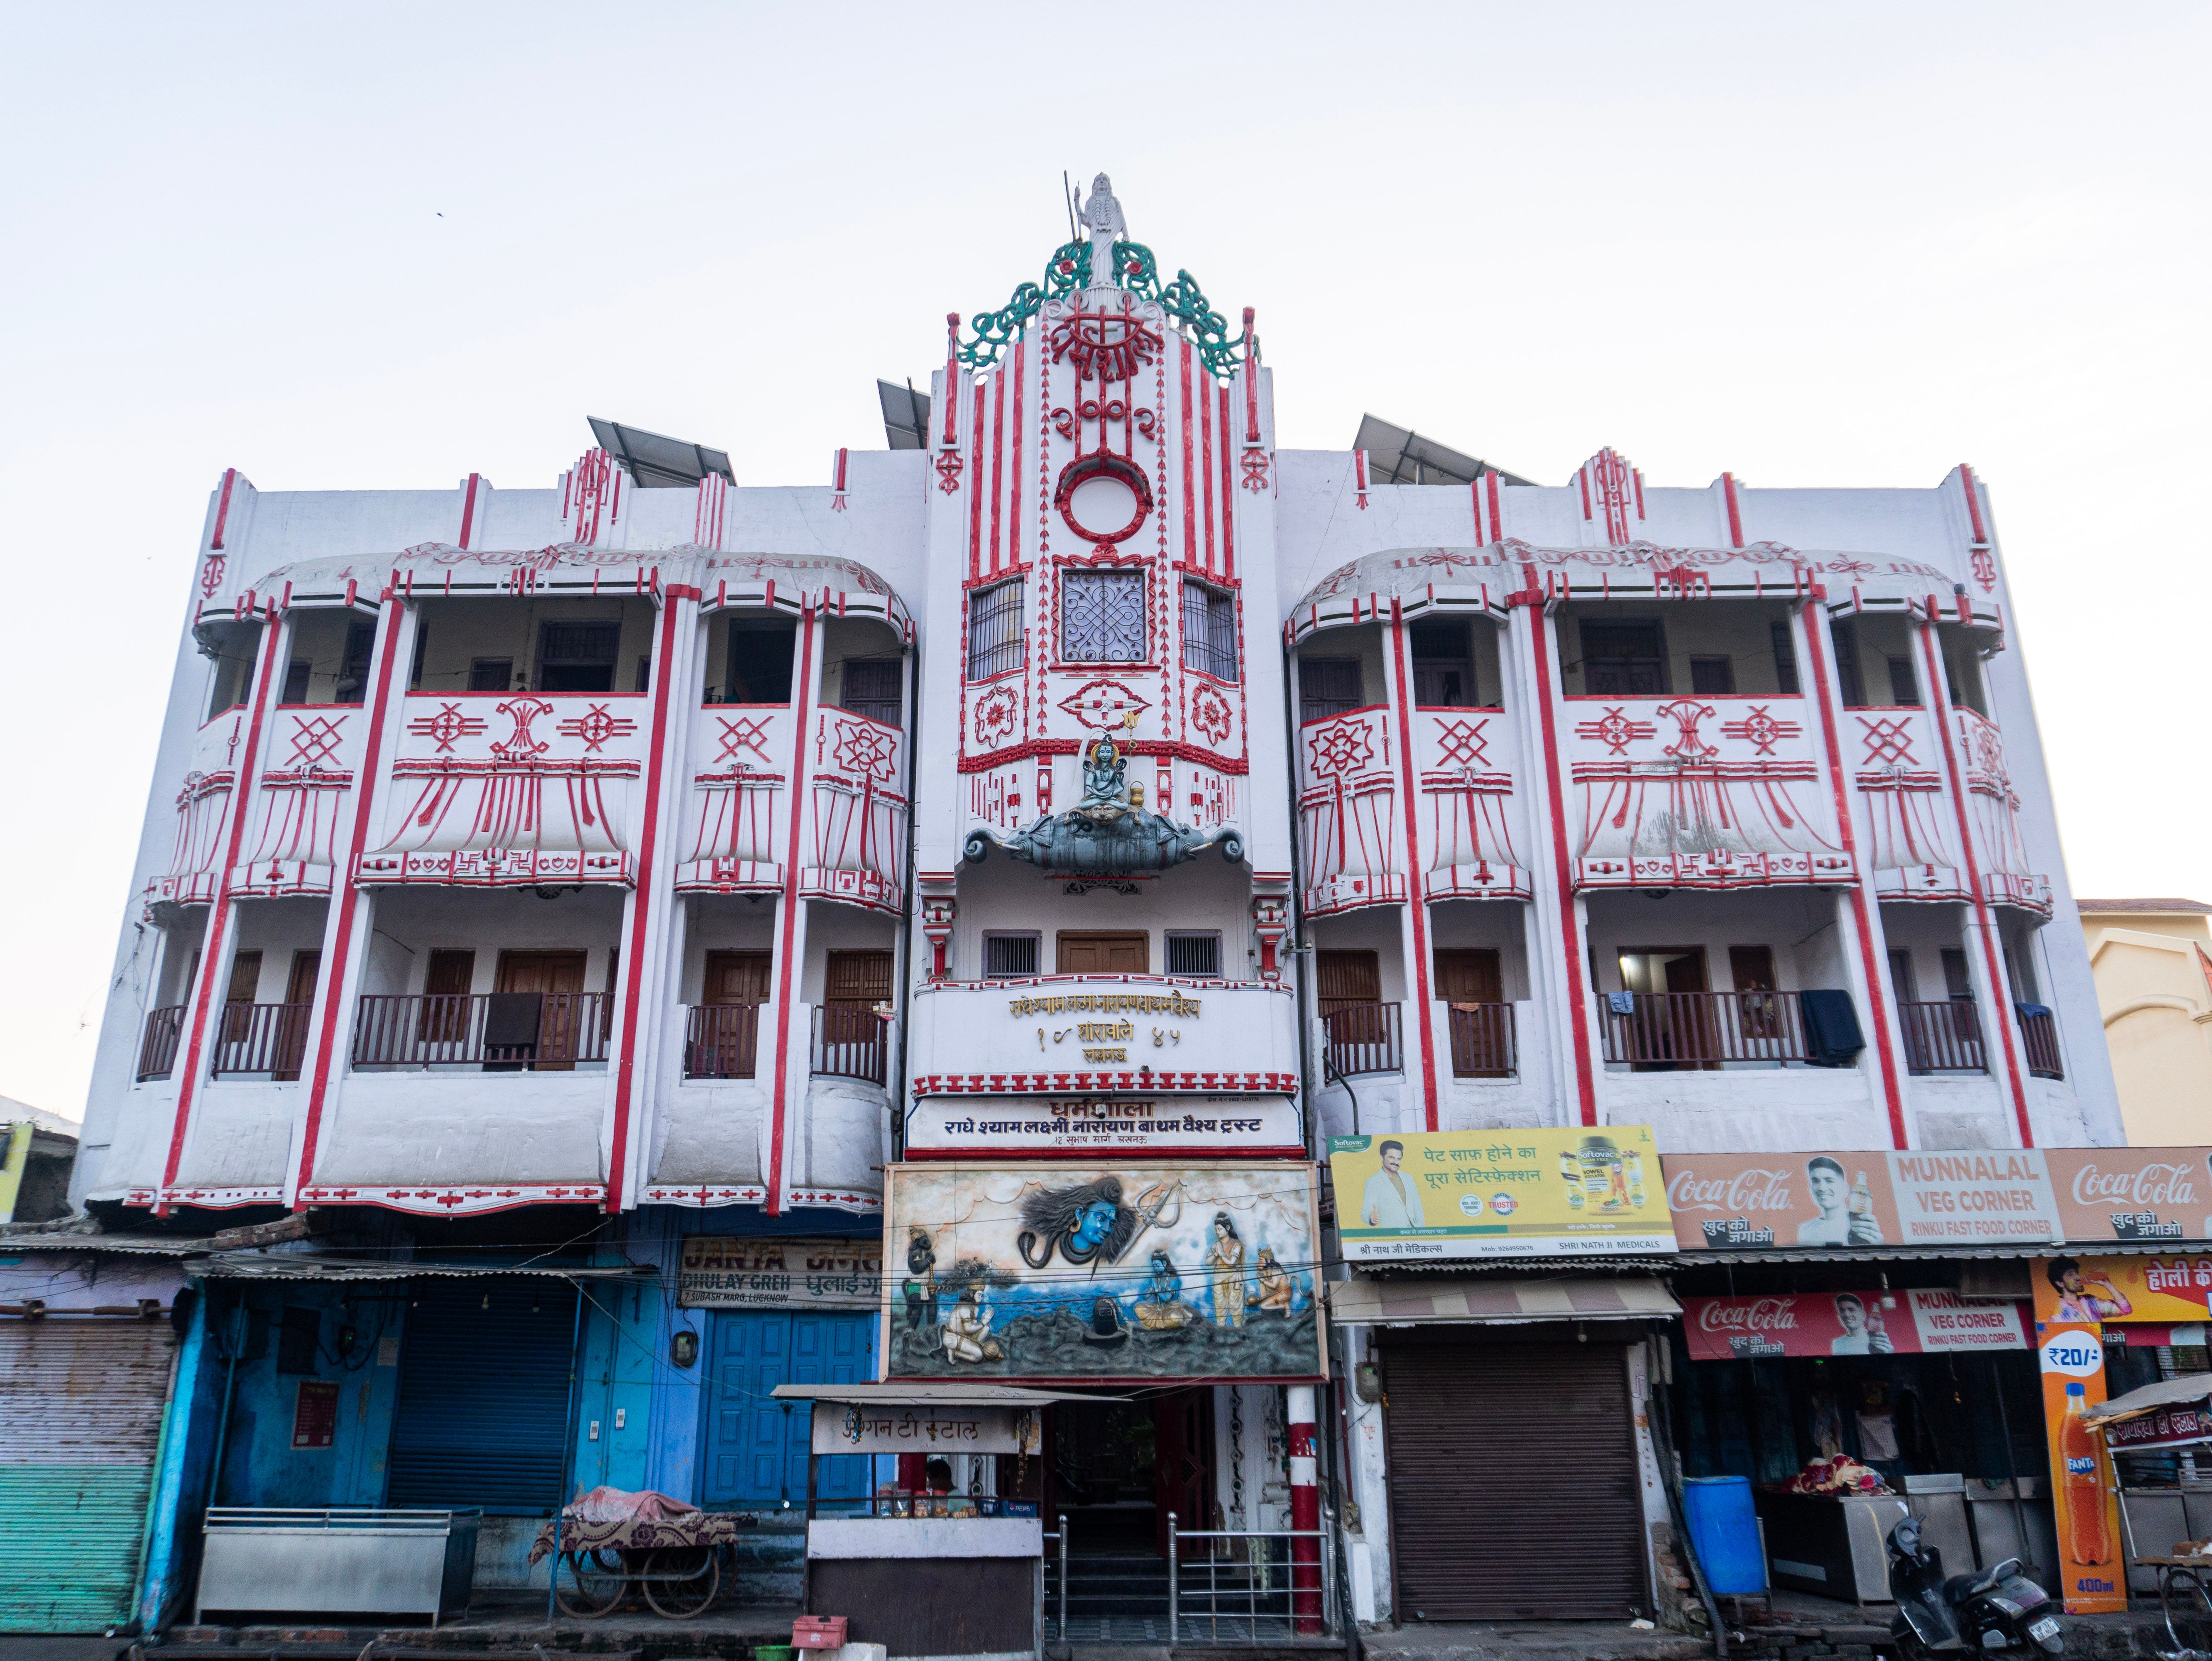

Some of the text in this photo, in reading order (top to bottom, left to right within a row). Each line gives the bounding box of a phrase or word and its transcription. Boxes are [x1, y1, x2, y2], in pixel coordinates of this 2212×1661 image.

[944, 1115, 1263, 1135] राधे श्याम लक्ष्मी नारायण बाथम वैश्य ट्रस्ट
[1066, 1136, 1088, 1146] सुभाष
[1093, 1133, 1112, 1143] मार्ग
[1118, 1135, 1147, 1144] लखनऊ
[1424, 1147, 1446, 1162] पेट
[1485, 1144, 1512, 1162] होने
[1517, 1147, 1537, 1159] का
[1897, 1156, 2040, 1182] MUNNALAL
[1424, 1173, 1449, 1189] पूरा
[2073, 1164, 2195, 1205] Coca-Cola
[1667, 1169, 1794, 1212] Coca-Cola
[1916, 1190, 2036, 1213] VEG CORNER
[1702, 1215, 1749, 1236] खुद को
[2110, 1209, 2156, 1229] खुद को
[2137, 1219, 2181, 1236] जगाओ
[1729, 1226, 1774, 1243] जगाओ
[1911, 1220, 2053, 1236] RINKU FAST FOOD CORNER
[1360, 1244, 1370, 1254] श्री
[1391, 1244, 1403, 1254] जी
[1405, 1243, 1443, 1254] मेडिकल्स
[1617, 1240, 1660, 1249] MEDICALS
[684, 1241, 787, 1270] JANTA
[806, 1245, 883, 1272] जनत
[681, 1273, 790, 1291] DHULAY GREH
[2146, 1261, 2190, 1290] होली
[806, 1273, 882, 1296] धुलाई गृ
[685, 1292, 721, 1302] 7-SUBASH
[749, 1294, 788, 1303] LUCKNOW
[1701, 1299, 1797, 1332] Coca-Cola
[1929, 1313, 2006, 1329] VEG CORNER
[1729, 1333, 1765, 1349] खुद को
[1928, 1333, 2017, 1345] RINKU FAST FOOD CORNER
[2102, 1330, 2126, 1343] गाओ
[1750, 1341, 1785, 1353] जगाओ
[897, 1412, 920, 1438] टी
[2068, 1457, 2095, 1470] FANTA
[2077, 1578, 2114, 1592] 400ml
